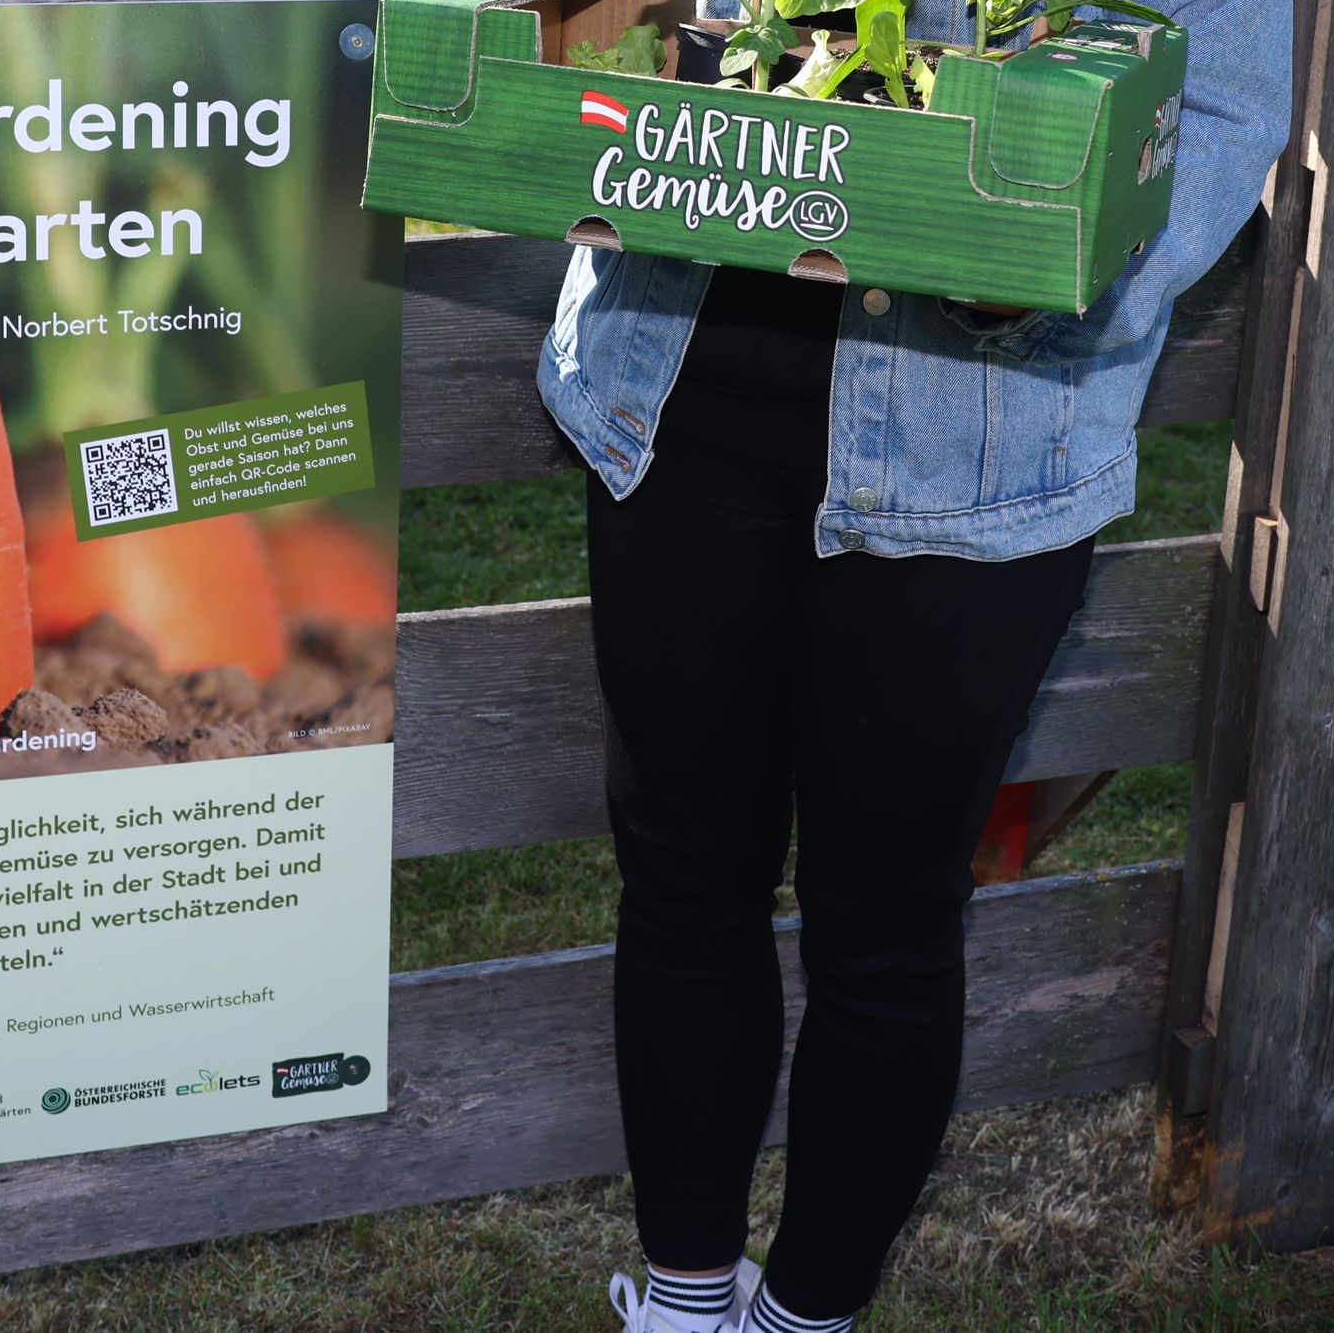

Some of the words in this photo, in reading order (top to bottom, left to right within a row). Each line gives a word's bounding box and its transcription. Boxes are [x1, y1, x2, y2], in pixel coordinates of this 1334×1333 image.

[635, 102, 851, 184] GÄRTNER
[593, 146, 793, 231] Gemüse
[800, 201, 838, 224] LGV
[4, 312, 107, 338] Norbert
[117, 306, 241, 334] Totschnig
[185, 428, 202, 440] Du
[207, 421, 240, 435] willst
[245, 414, 291, 428] wissen,
[296, 404, 347, 419] welches
[187, 442, 219, 456] Obst
[224, 435, 247, 450] und
[252, 429, 303, 444] Gemüse
[308, 424, 327, 434] bei
[332, 420, 353, 430] uns
[189, 456, 233, 476] gerade
[239, 450, 279, 464] Saison
[284, 441, 310, 456] hat?
[316, 438, 347, 450] Dann
[191, 472, 237, 490] einfach
[242, 461, 300, 480] QR-Code
[305, 453, 355, 468] scannen
[193, 492, 216, 506] und
[221, 476, 306, 500] herausfinden!
[289, 730, 306, 738] BILD
[116, 806, 162, 828] sich
[173, 794, 275, 822] während
[286, 791, 324, 810] der
[88, 850, 113, 864] zu
[123, 837, 246, 860] versorgen.
[257, 823, 325, 846] Damit
[84, 880, 103, 897] in
[113, 874, 152, 894] der
[163, 865, 225, 888] Stadt
[236, 860, 269, 880] bei
[280, 853, 320, 875] und
[37, 912, 80, 934] und
[91, 891, 297, 928] wertschätzenden
[8, 1015, 84, 1034] Regionen
[92, 1006, 121, 1022] und
[129, 987, 274, 1016] Wasserwirtschaft
[75, 1080, 165, 1098] ÖSTERREICHISCHE
[75, 1088, 165, 1107] BUNDESFORSTE
